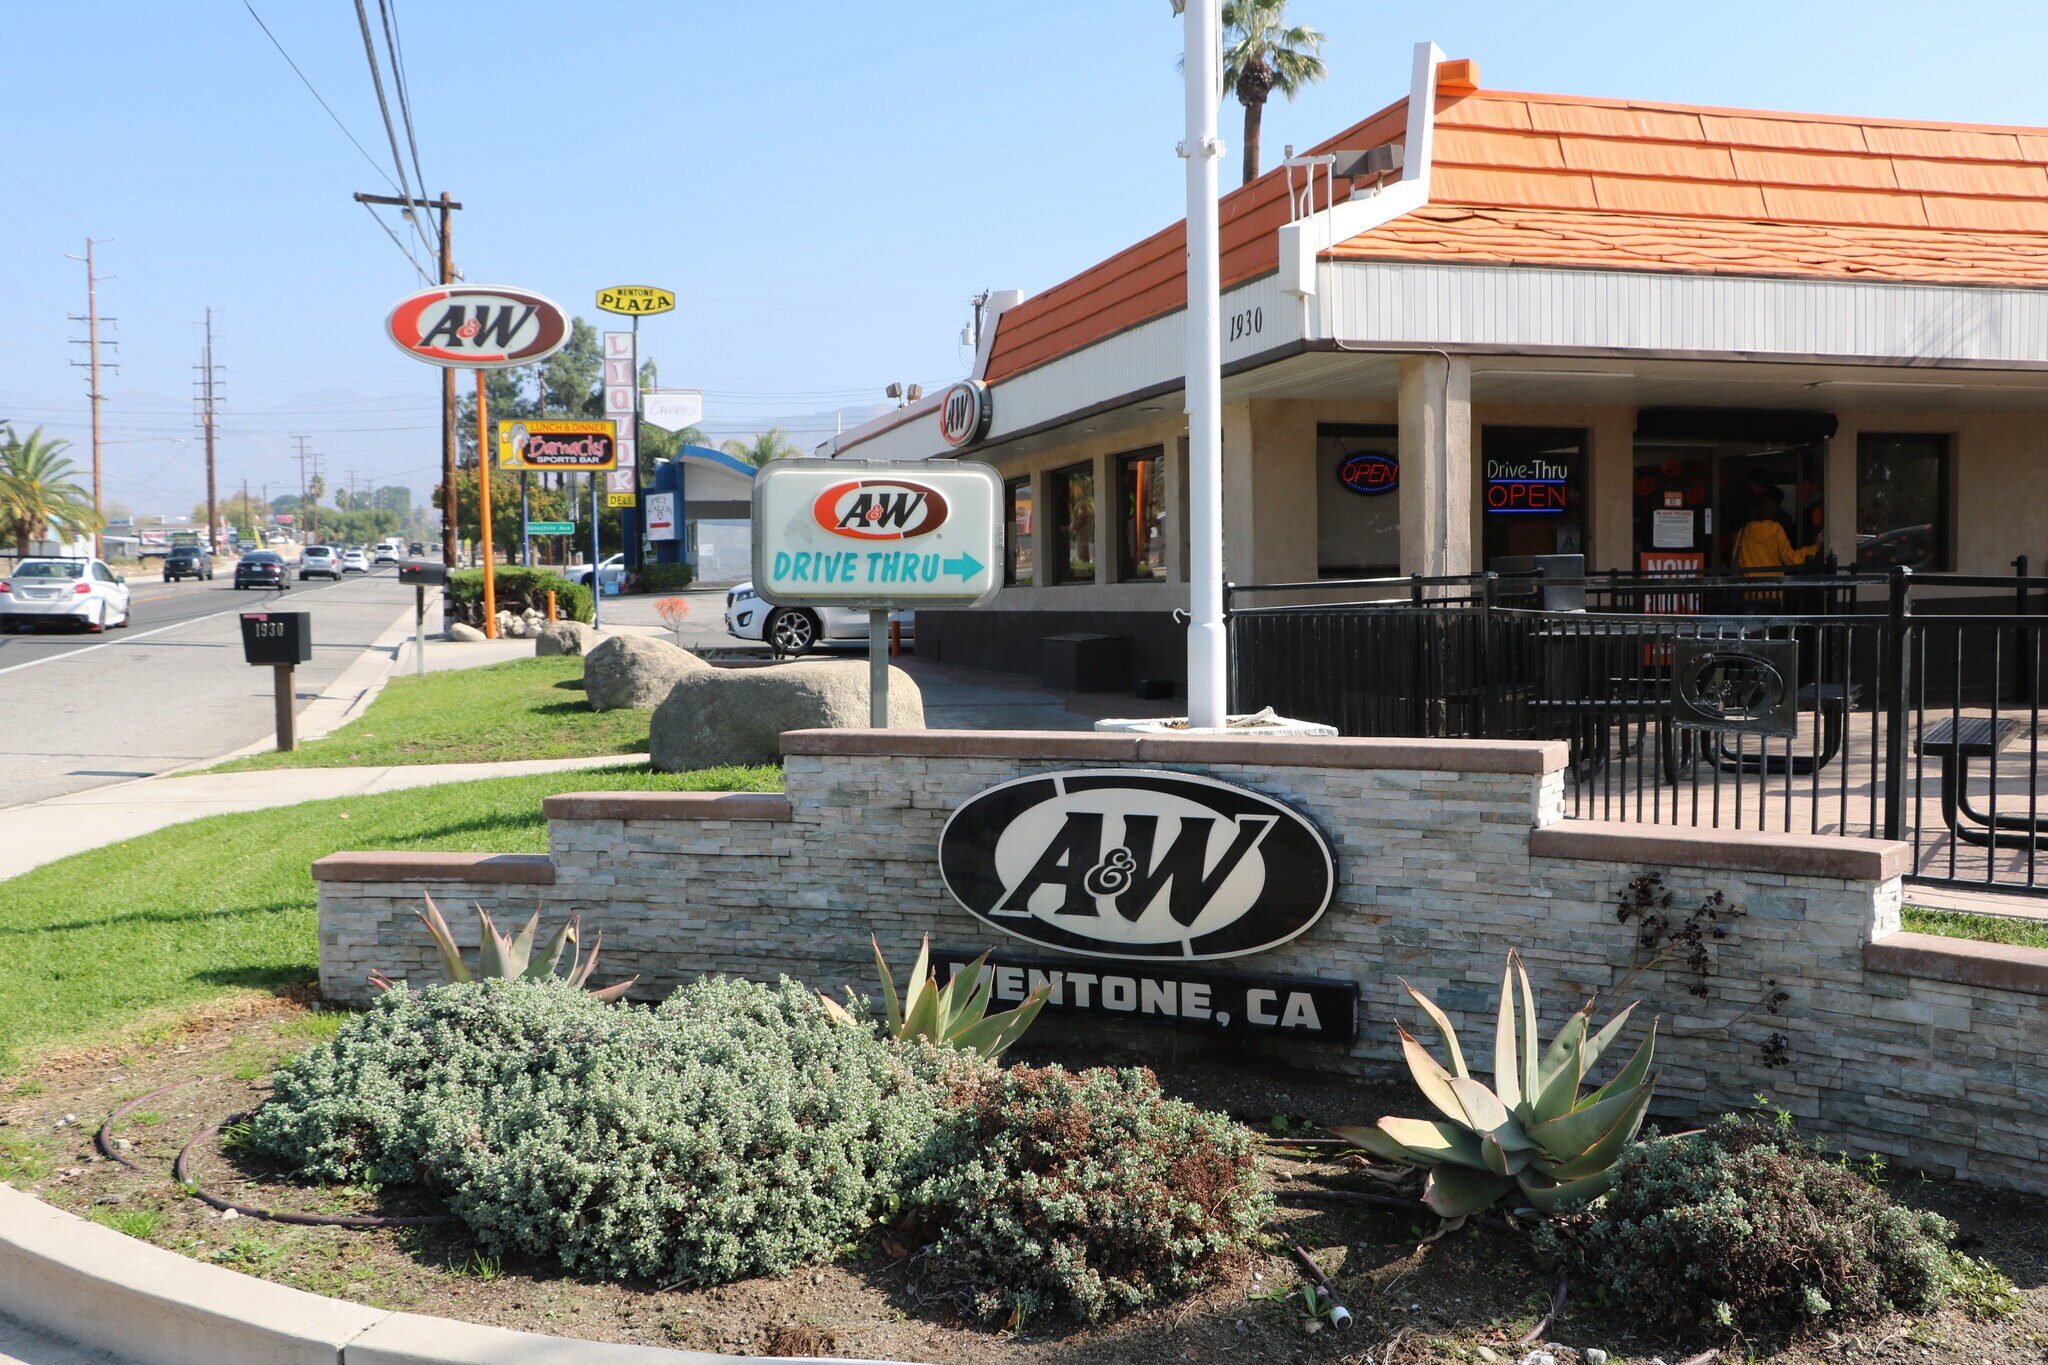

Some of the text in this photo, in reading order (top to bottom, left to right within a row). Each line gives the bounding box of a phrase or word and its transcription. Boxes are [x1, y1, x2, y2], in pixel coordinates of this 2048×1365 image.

[601, 293, 673, 311] PLAZA
[617, 288, 655, 297] MENTONE
[416, 304, 541, 349] A&W
[1230, 306, 1263, 342] 1930
[607, 335, 634, 491] LIQUOR
[946, 393, 969, 433] A&W
[530, 424, 607, 432] LUNCH & DINNER
[579, 456, 600, 464] BAR
[1487, 459, 1568, 479] Drive-Thru
[1342, 463, 1399, 483] OPEN
[650, 496, 667, 506] PET
[1488, 484, 1566, 507] OPEN
[836, 492, 927, 529] A&W
[1563, 534, 1575, 549] A
[773, 551, 940, 583] DRIVE THRU
[1647, 559, 1699, 580] NOW
[255, 622, 284, 638] 1930
[992, 811, 1278, 928] A&W
[949, 962, 1322, 1030] ENTONE, CA
